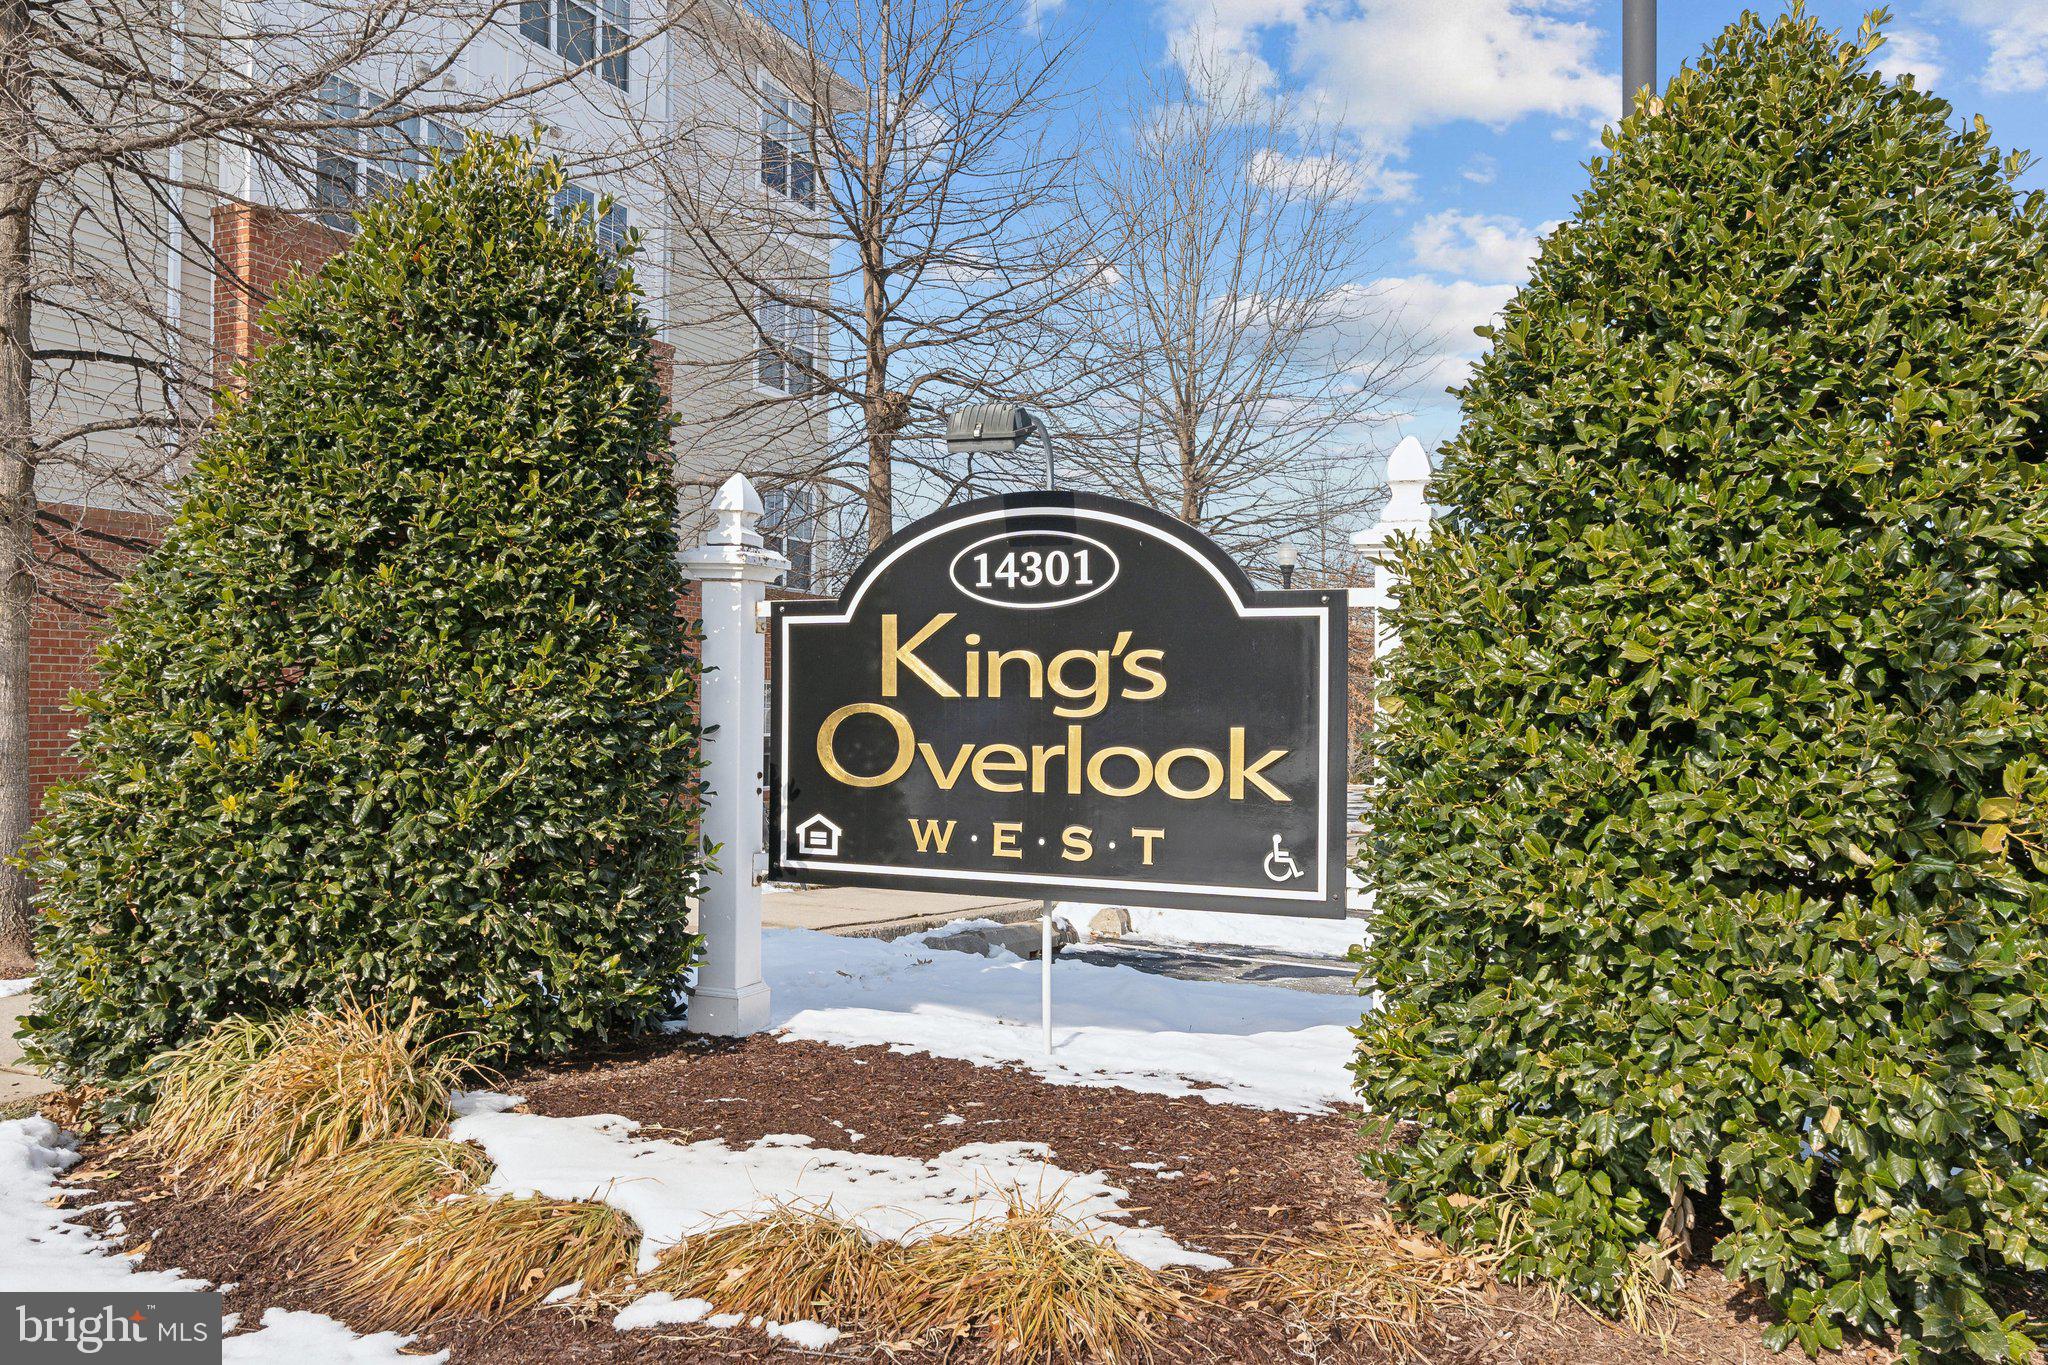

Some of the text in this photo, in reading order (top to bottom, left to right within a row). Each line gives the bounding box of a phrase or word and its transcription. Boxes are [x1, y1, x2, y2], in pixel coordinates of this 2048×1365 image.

[973, 549, 1094, 589] 14301
[881, 612, 1168, 718] King's
[816, 702, 1293, 802] Overlook
